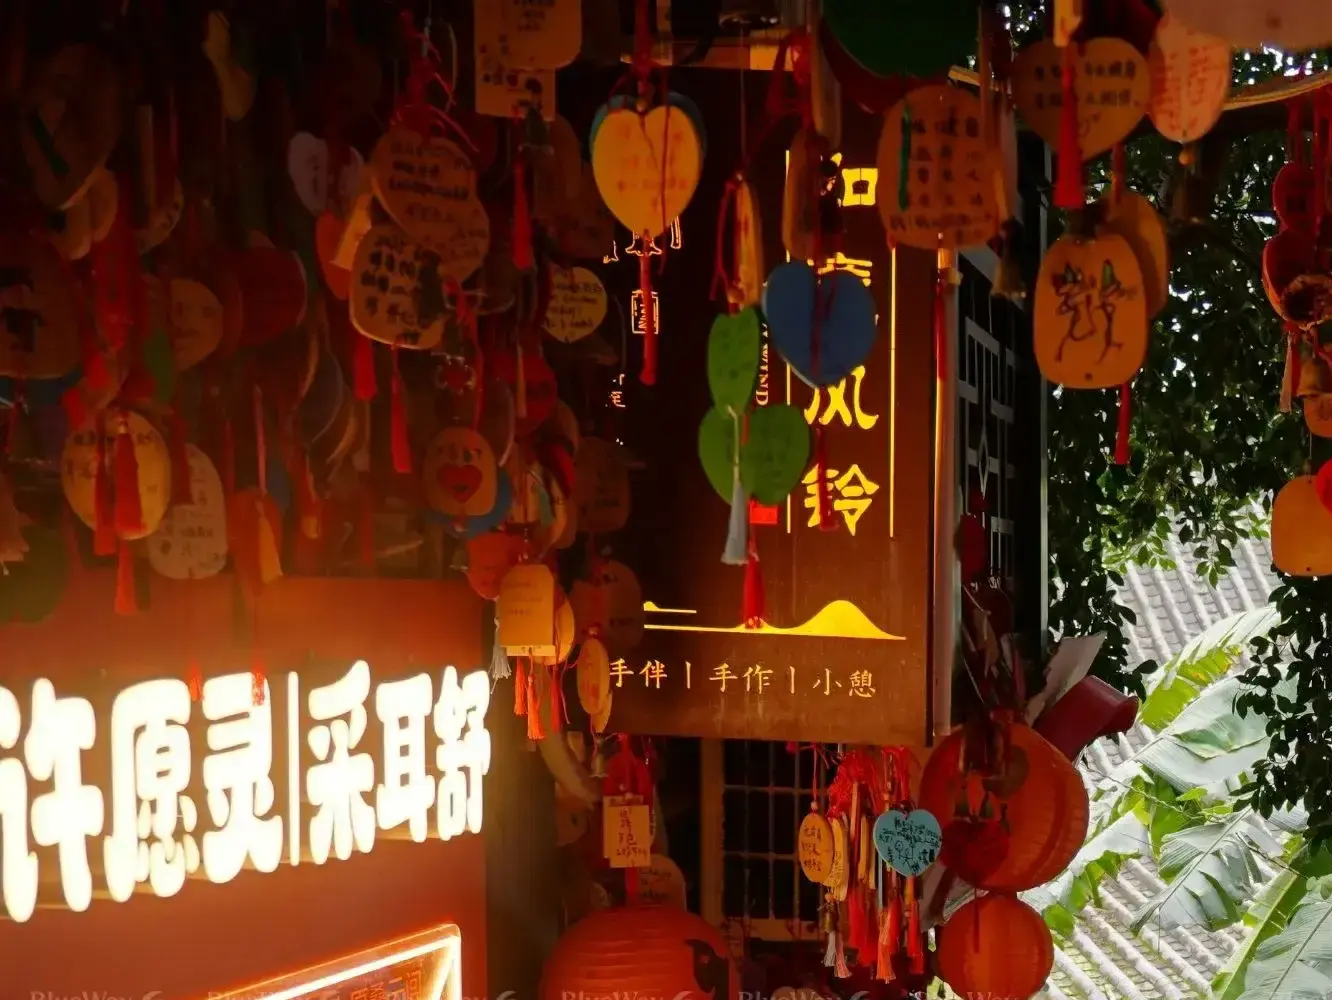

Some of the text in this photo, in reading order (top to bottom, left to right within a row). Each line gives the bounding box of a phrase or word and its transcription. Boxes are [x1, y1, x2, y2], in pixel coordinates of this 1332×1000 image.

[608, 658, 877, 699] 手伴 手作 小憩
